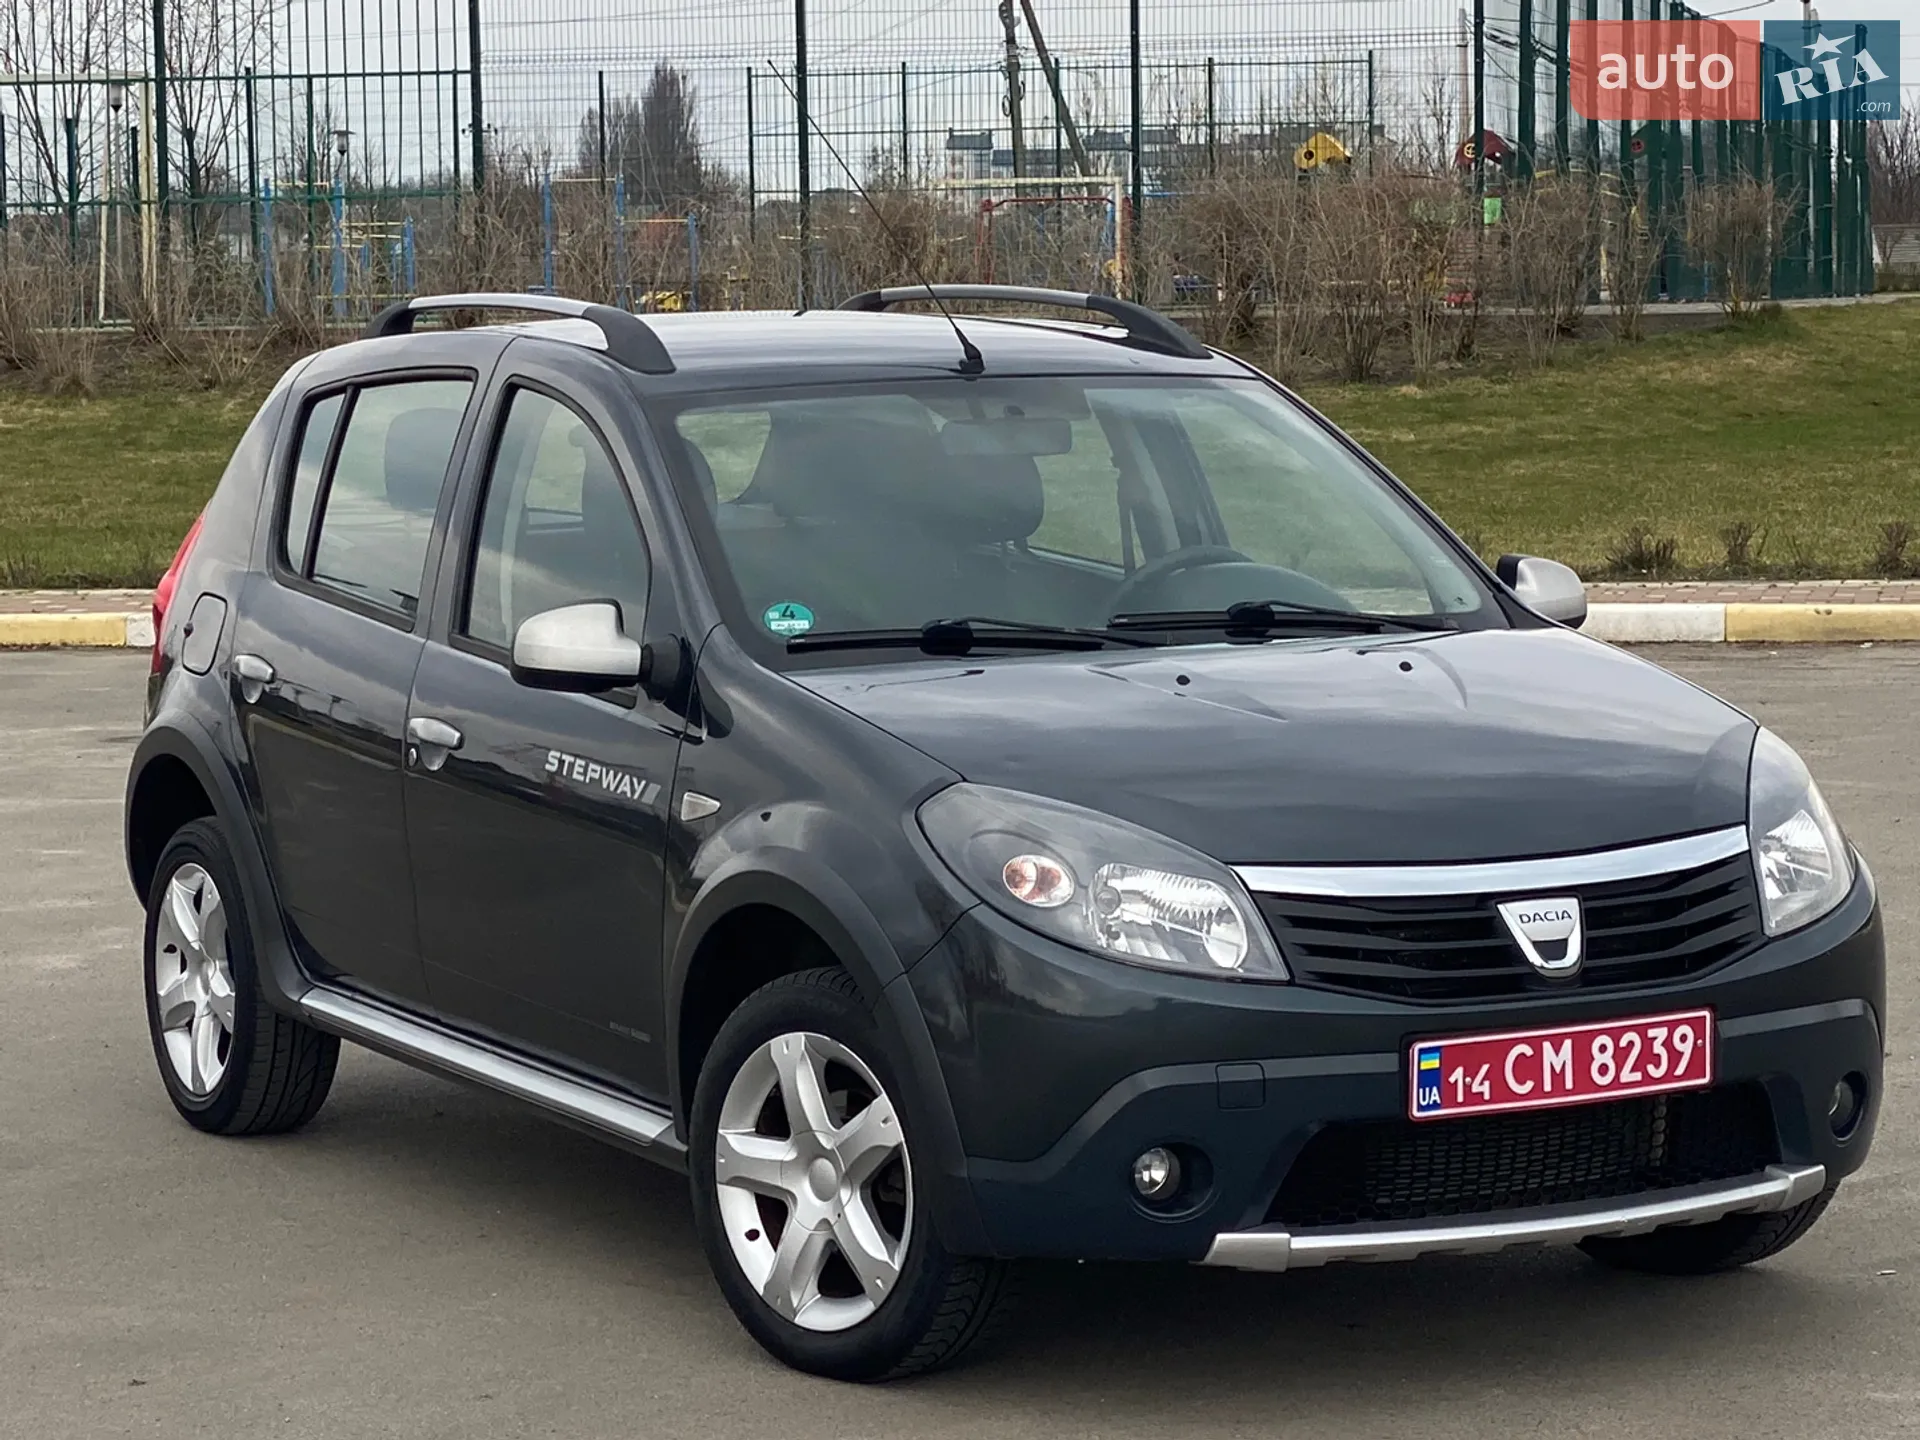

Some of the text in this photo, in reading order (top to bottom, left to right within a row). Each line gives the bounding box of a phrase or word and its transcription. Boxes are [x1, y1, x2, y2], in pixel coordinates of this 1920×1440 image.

[781, 604, 796, 619] 4
[545, 750, 646, 800] STEPWAY
[1518, 909, 1573, 924] DACIA
[1504, 1039, 1574, 1095] CM
[1590, 1024, 1695, 1087] 8239
[1419, 1087, 1441, 1106] UA
